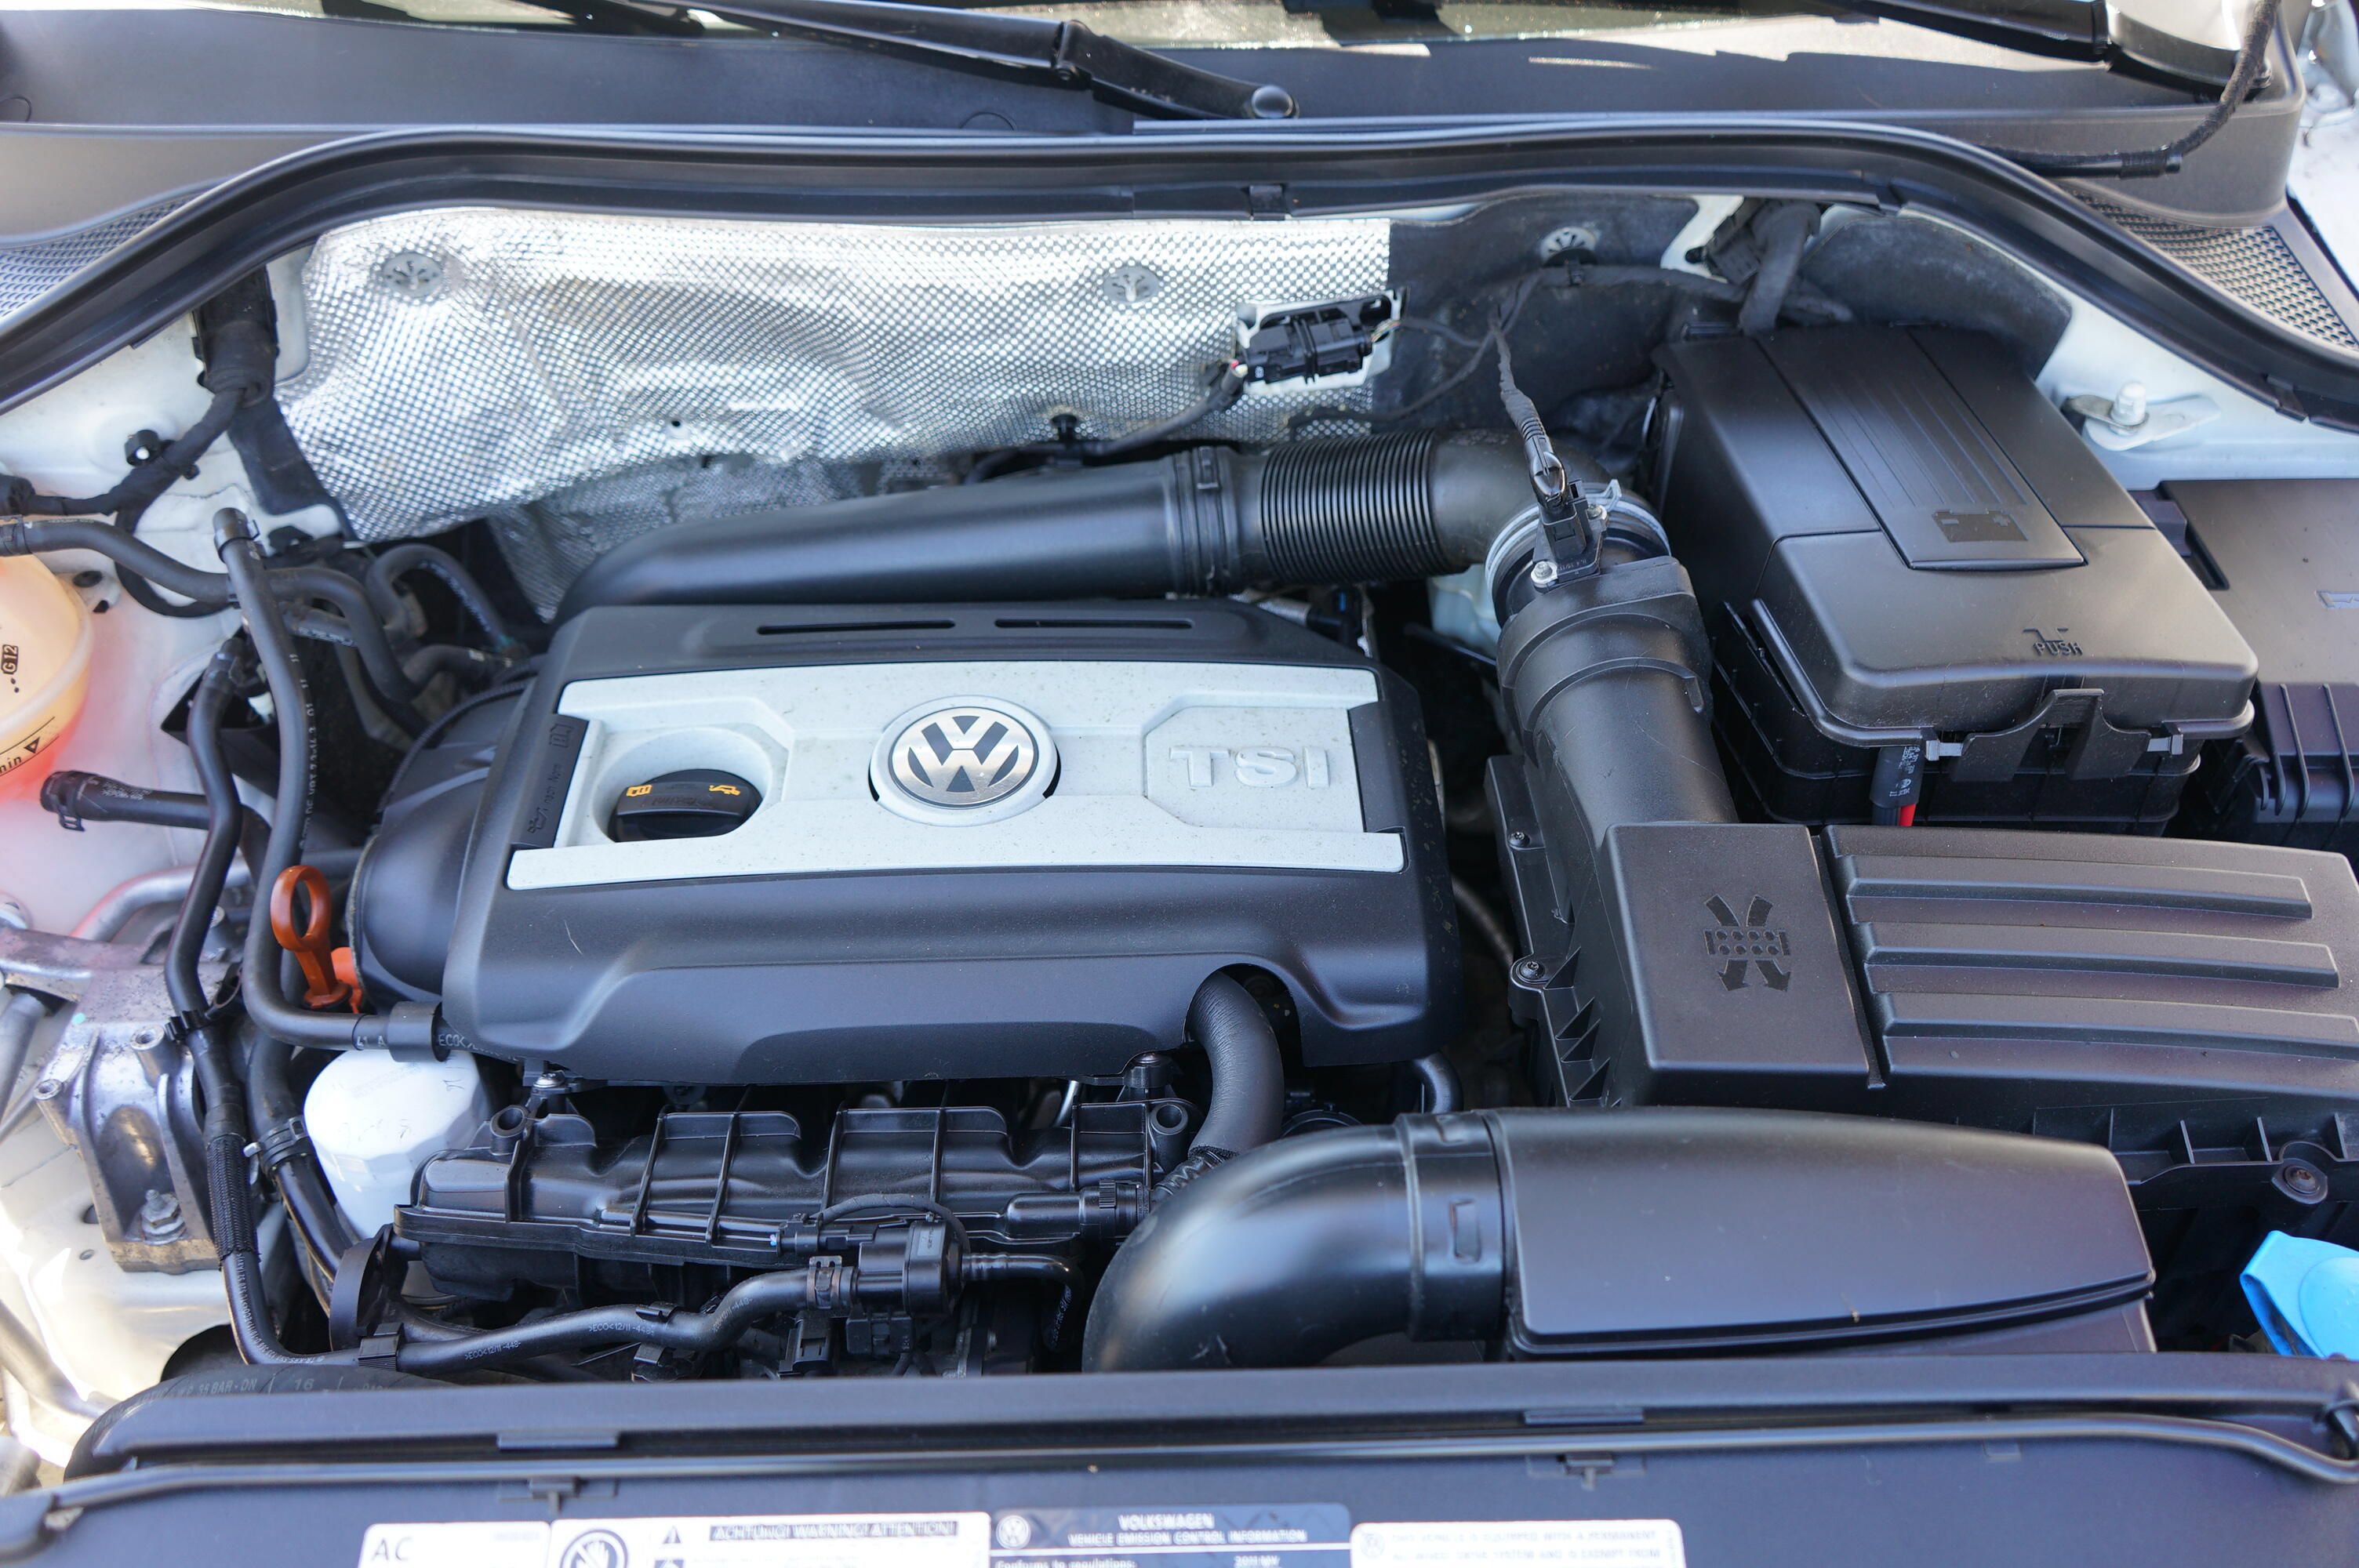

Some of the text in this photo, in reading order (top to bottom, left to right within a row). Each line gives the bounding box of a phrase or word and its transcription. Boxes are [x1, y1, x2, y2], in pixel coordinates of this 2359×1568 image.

[2, 644, 17, 673] G12
[2033, 643, 2083, 656] PUSH
[1169, 746, 1331, 787] TSI
[1118, 1514, 1215, 1530] VOLKSWAGEN
[1067, 1529, 1308, 1547] VEHICLE EMISSION CONTROL INFORMATION
[370, 1537, 413, 1561] AC
